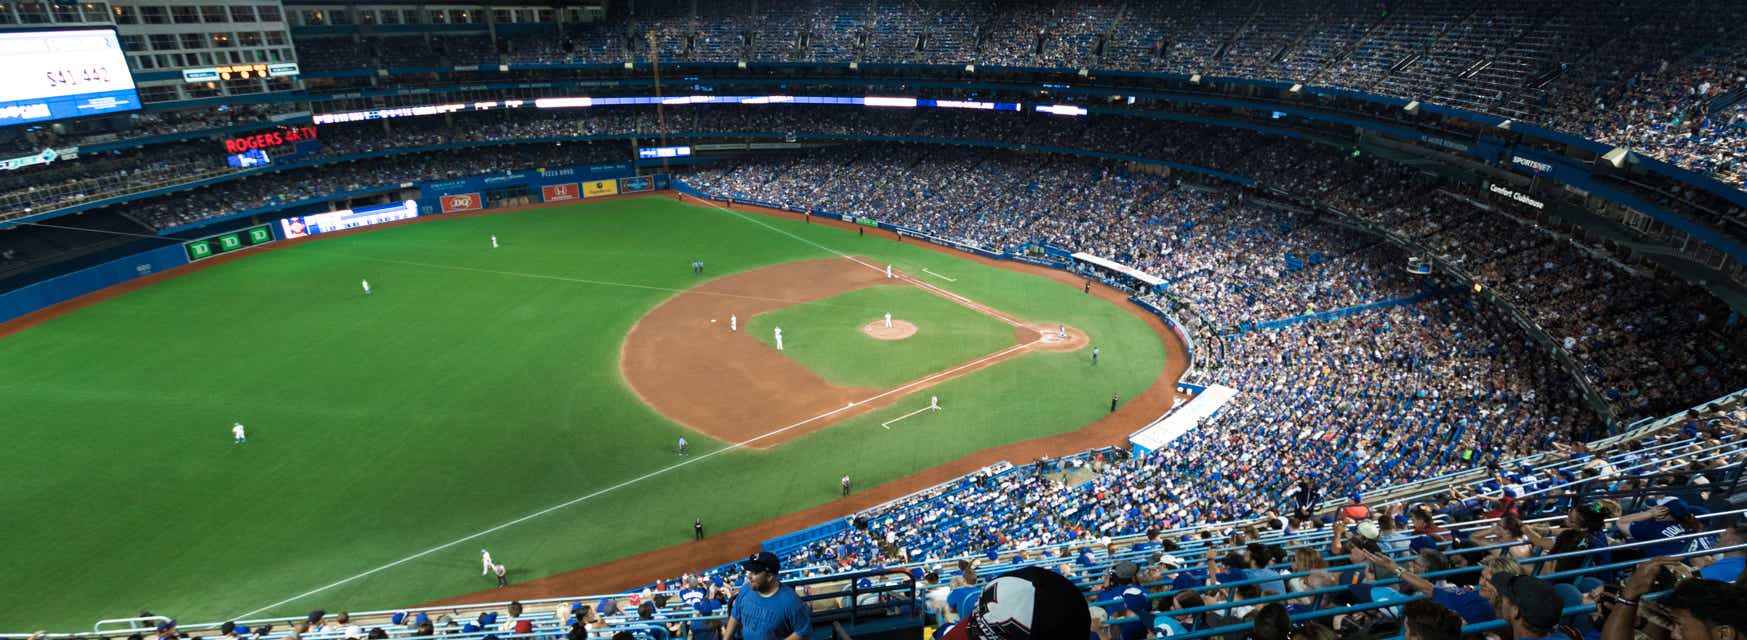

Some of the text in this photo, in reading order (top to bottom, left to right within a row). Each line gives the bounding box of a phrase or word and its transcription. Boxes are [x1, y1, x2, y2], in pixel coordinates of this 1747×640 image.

[225, 133, 283, 153] ROGERS
[1512, 155, 1552, 172] SPORTSNET
[1489, 183, 1545, 210] Comfort Clubhouse
[253, 230, 266, 240] TD
[223, 237, 238, 247] TD
[193, 244, 208, 254] TD
